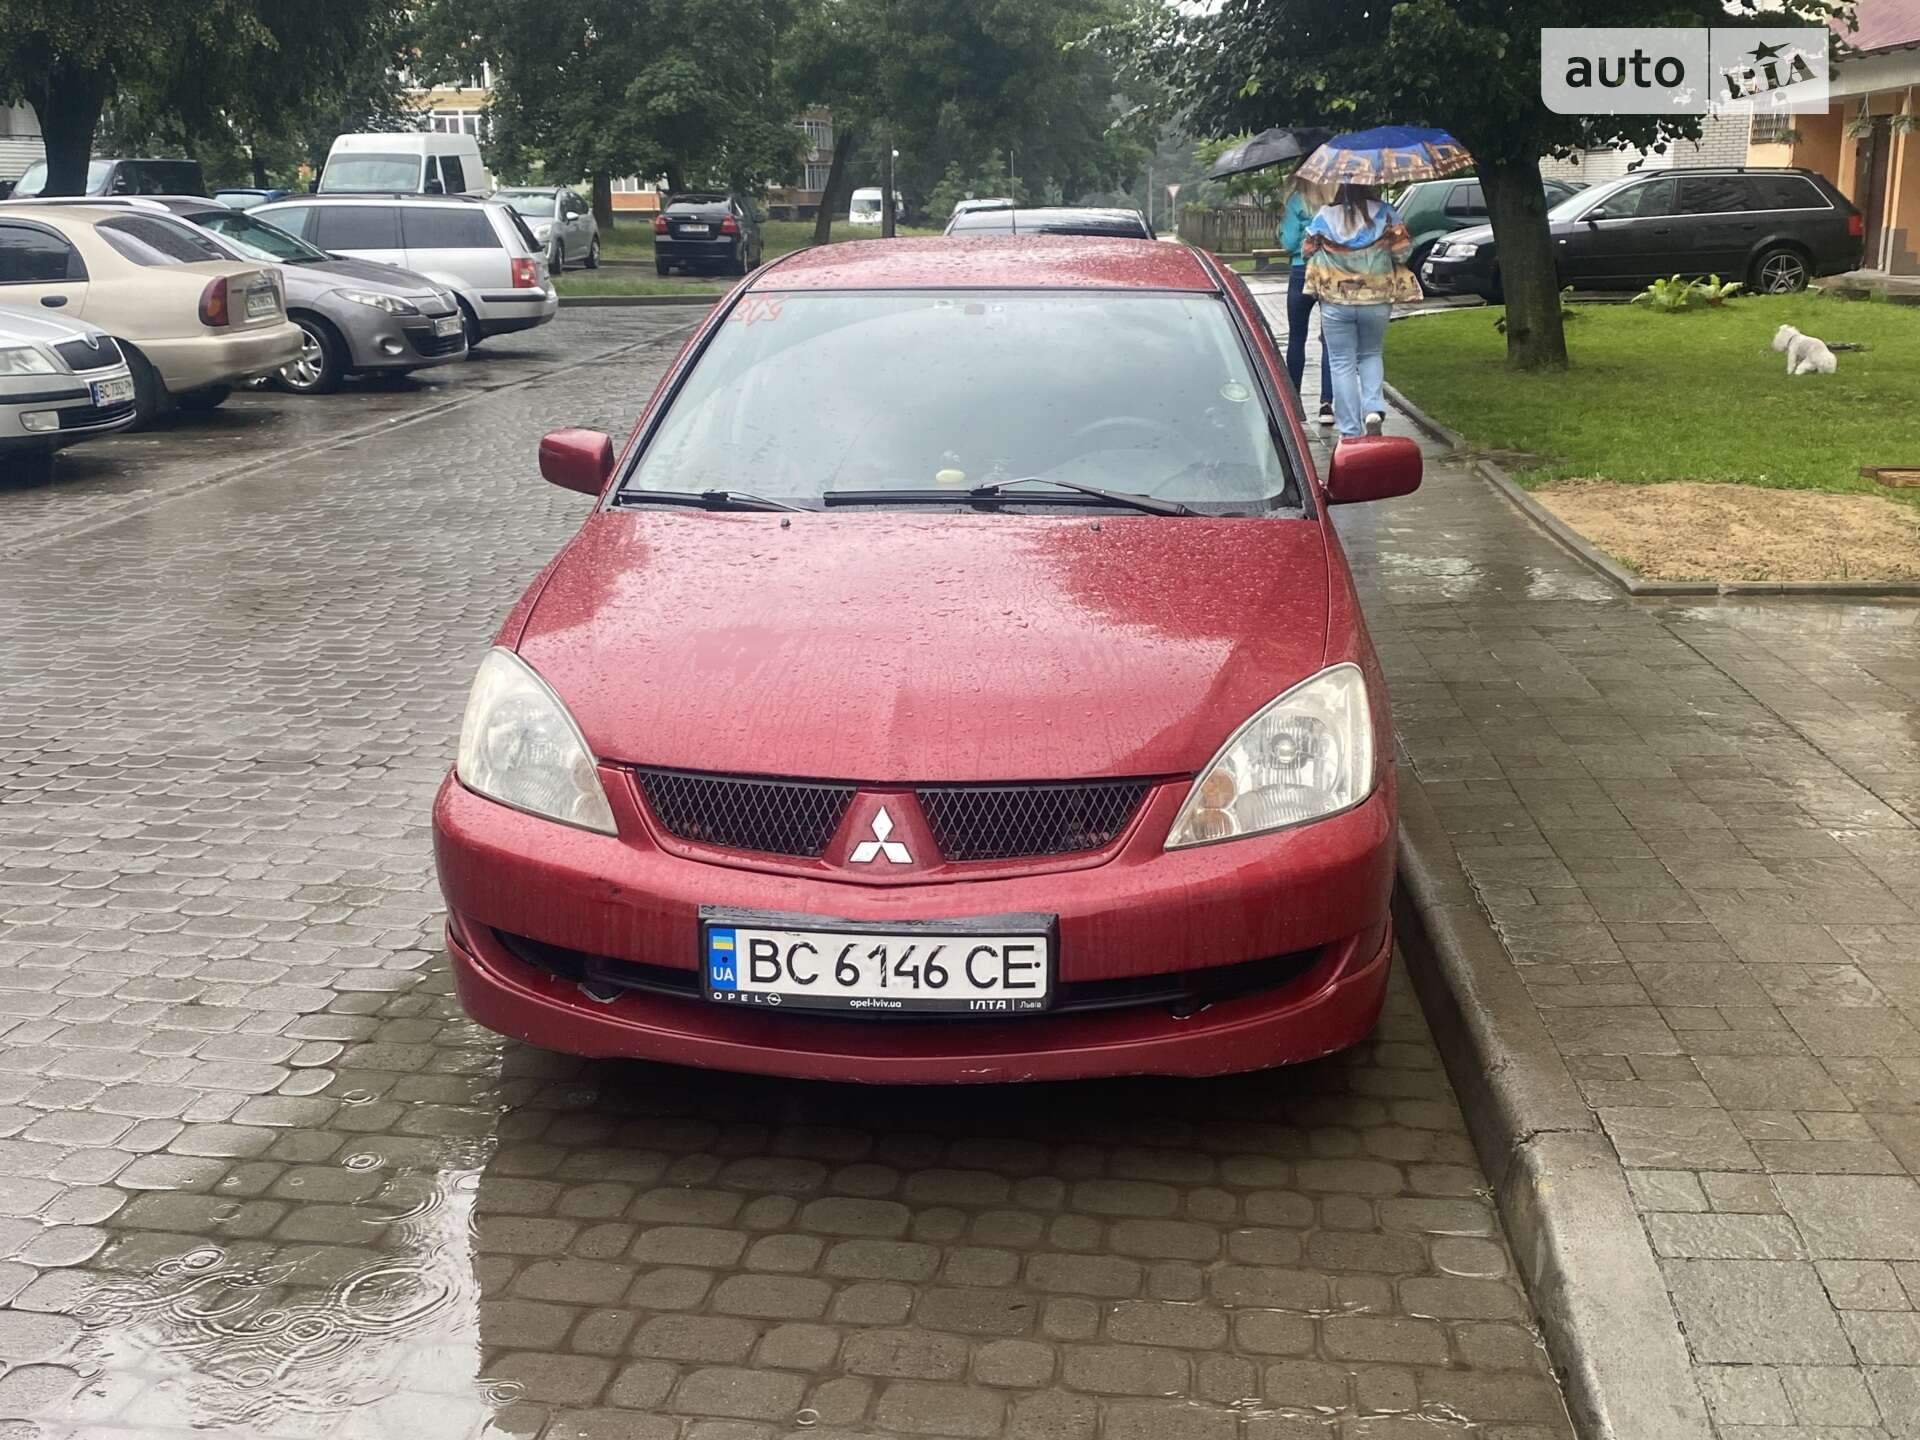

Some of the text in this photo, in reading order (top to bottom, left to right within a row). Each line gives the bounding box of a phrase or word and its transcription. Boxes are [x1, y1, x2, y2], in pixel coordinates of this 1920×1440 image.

[749, 938, 1036, 989] BC 6146 CE
[713, 966, 735, 981] UA
[713, 992, 762, 1003] OPEL
[850, 998, 902, 1008] opel-lviv.ua
